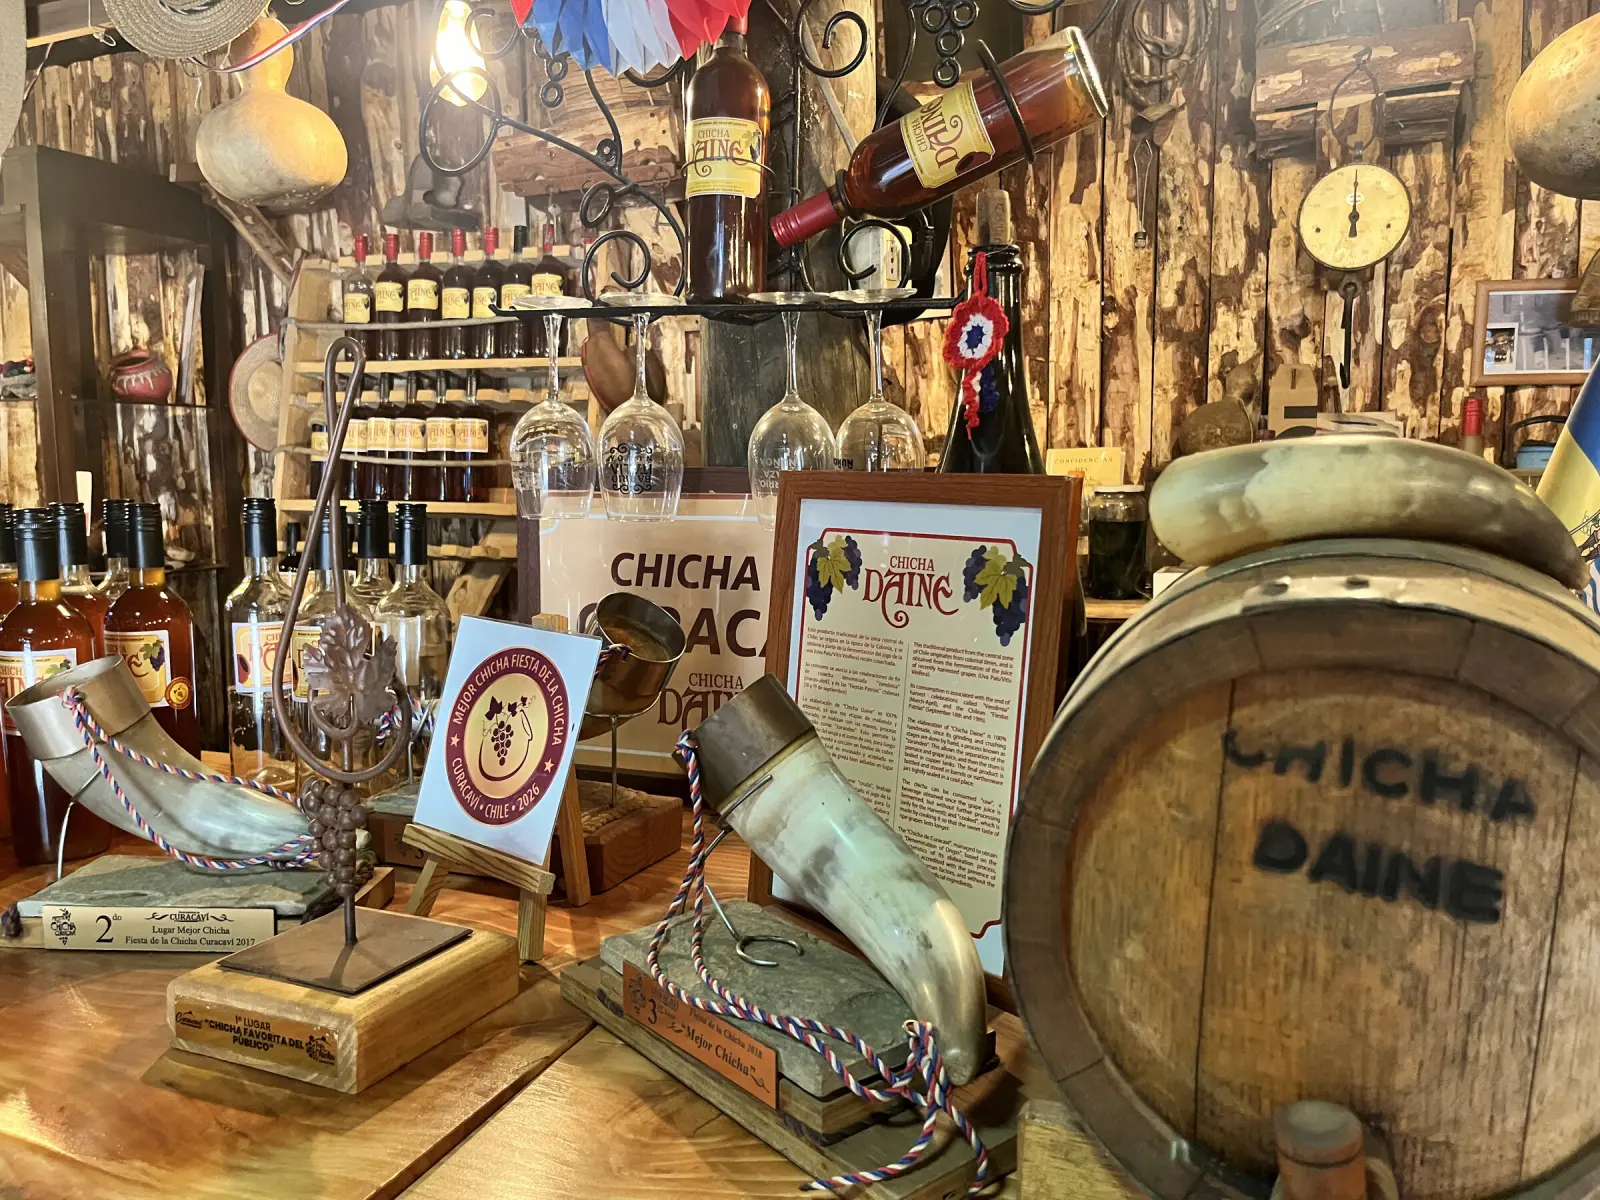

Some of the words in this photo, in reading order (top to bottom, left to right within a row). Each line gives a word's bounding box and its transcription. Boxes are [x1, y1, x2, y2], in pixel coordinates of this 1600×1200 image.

[697, 129, 730, 139] CHICHA
[911, 117, 928, 152] CHICHA
[692, 139, 748, 177] AINE
[611, 552, 760, 591] CHICHA
[890, 556, 934, 572] CHICHA
[862, 568, 959, 628] DAINE
[476, 656, 510, 686] CHICHA
[512, 654, 540, 672] FIESTA
[539, 666, 552, 683] DE
[546, 678, 559, 697] LA
[689, 672, 744, 690] CHICHA
[452, 684, 478, 725] MEJOR
[552, 696, 565, 746] CHICHA
[452, 758, 482, 811] CURACAVÍ
[485, 804, 509, 819] CHILE
[518, 782, 540, 812] 2026
[1222, 728, 1538, 823] CHICHA
[1252, 815, 1504, 925] DAINE
[152, 926, 176, 935] Lugar
[178, 926, 200, 935] Mejor
[202, 926, 230, 934] Chicha
[170, 912, 210, 921] CURACAVÍ
[126, 936, 148, 944] Fiesta
[162, 936, 168, 944] la
[170, 937, 198, 945] Chicha
[200, 937, 234, 946] Curacaví
[236, 938, 256, 946] 2017
[648, 998, 658, 1024] 3
[204, 1018, 241, 1034] "CHICHA
[244, 1028, 286, 1045] FAVORITA
[288, 1038, 304, 1050] DEL
[244, 1020, 271, 1032] LUGAR
[708, 1021, 716, 1030] de
[717, 1024, 723, 1034] la
[724, 1029, 746, 1048] Chicha
[681, 1024, 713, 1051] "Mejor
[716, 1044, 756, 1076] Chicha"
